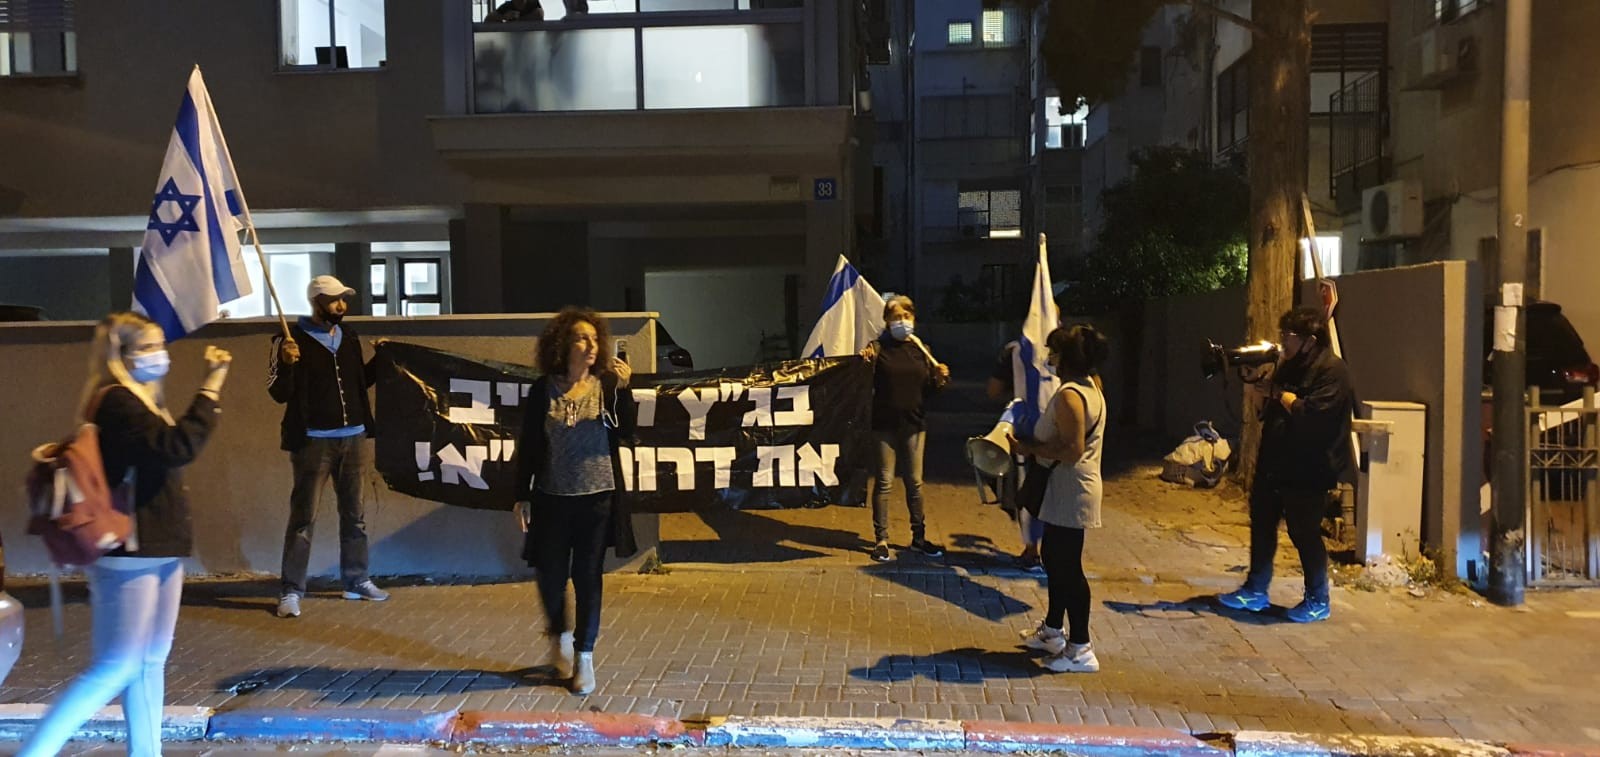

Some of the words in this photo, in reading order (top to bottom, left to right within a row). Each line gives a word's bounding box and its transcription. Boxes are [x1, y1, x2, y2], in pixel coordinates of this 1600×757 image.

[818, 182, 833, 197] 33
[1514, 213, 1523, 227] 2
[752, 441, 840, 488] את
